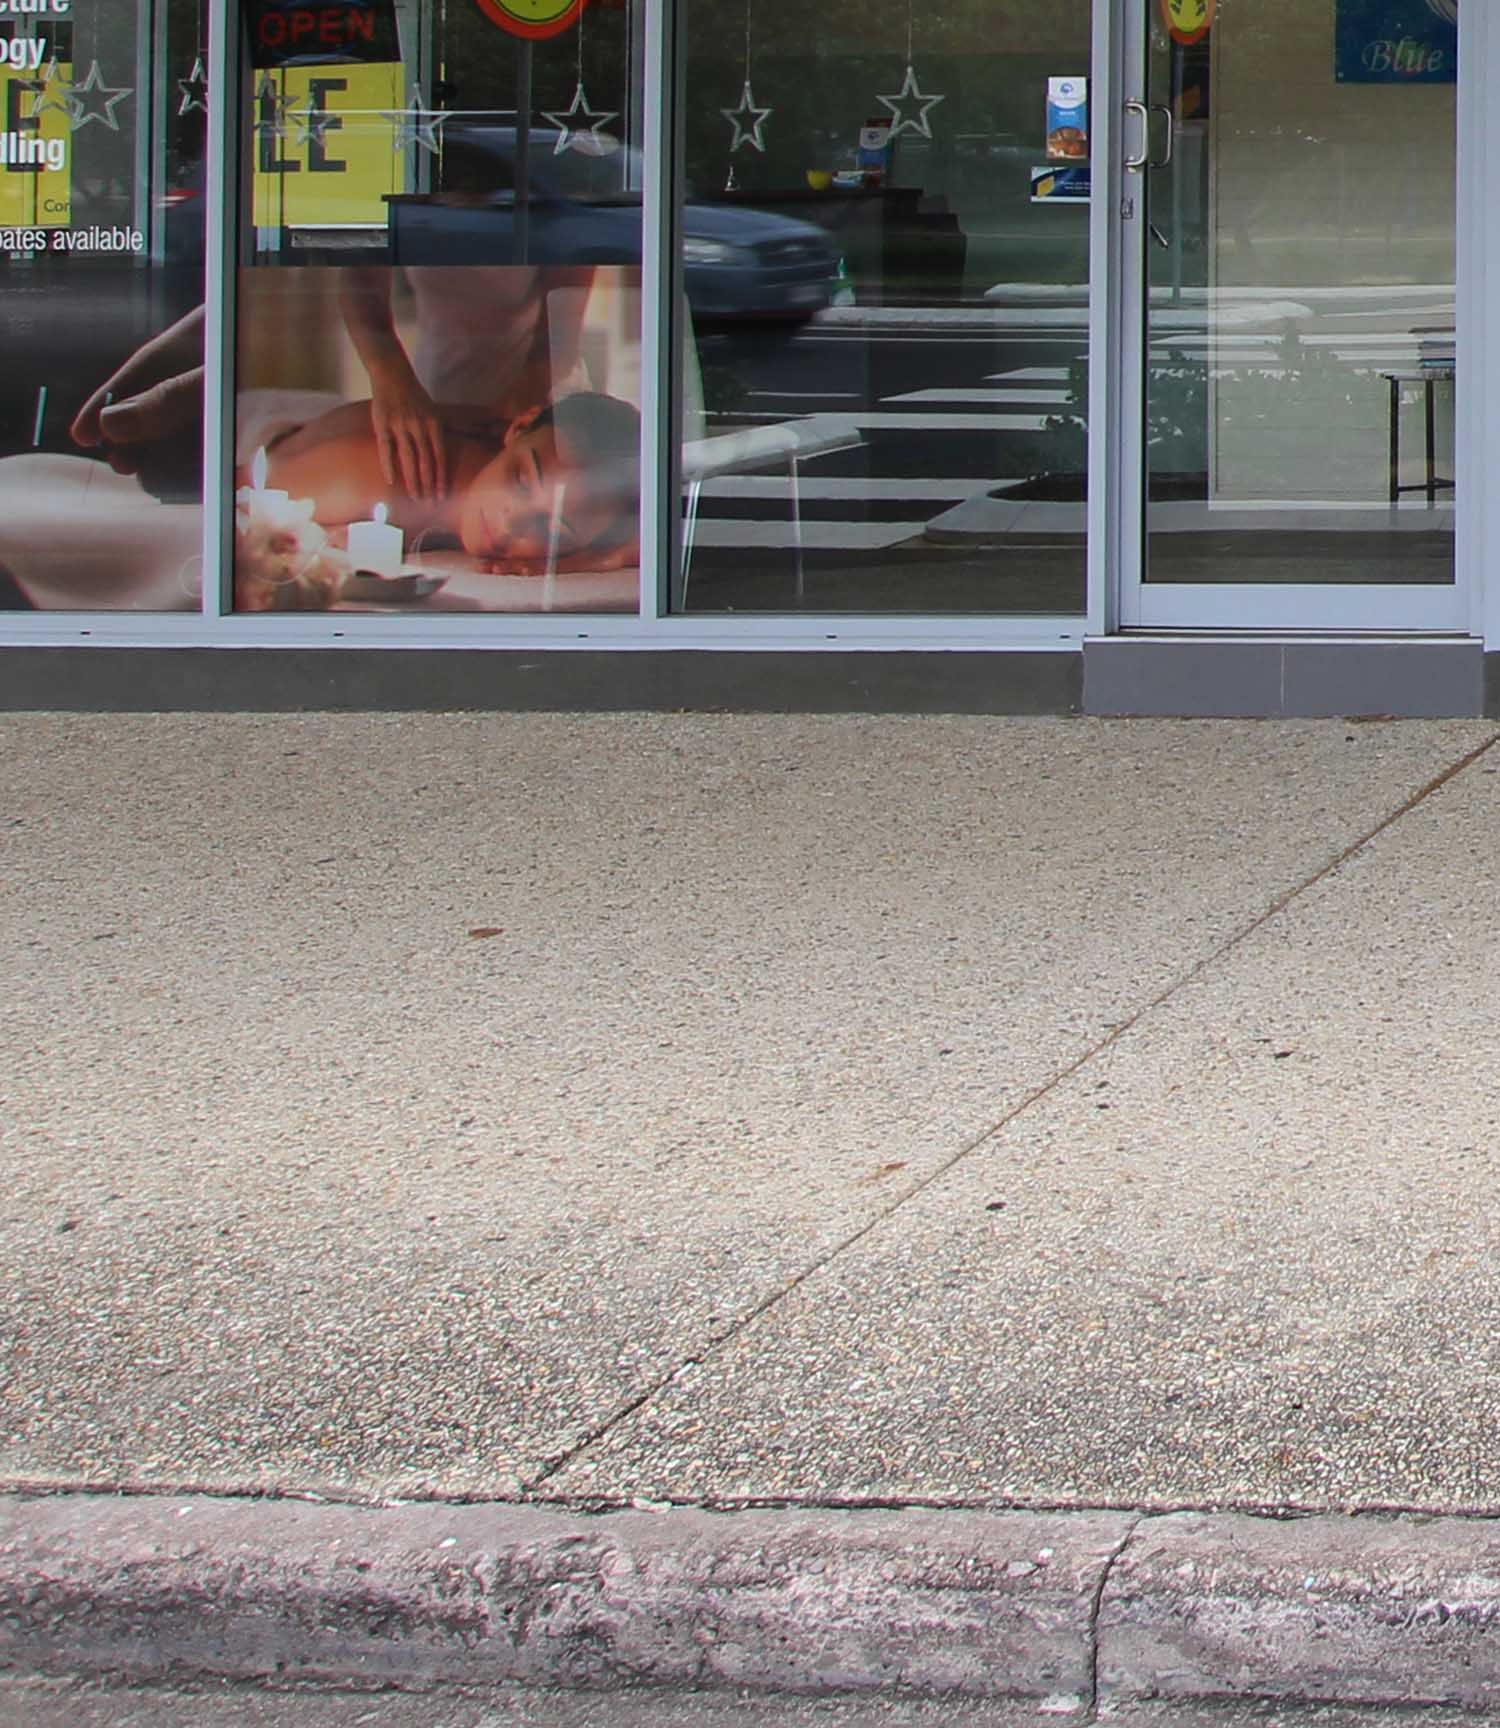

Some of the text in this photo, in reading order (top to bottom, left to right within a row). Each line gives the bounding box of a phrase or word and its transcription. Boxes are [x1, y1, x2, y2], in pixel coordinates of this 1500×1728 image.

[257, 8, 375, 46] OPEN
[1362, 36, 1443, 73] Blue
[0, 225, 143, 251] ates available
